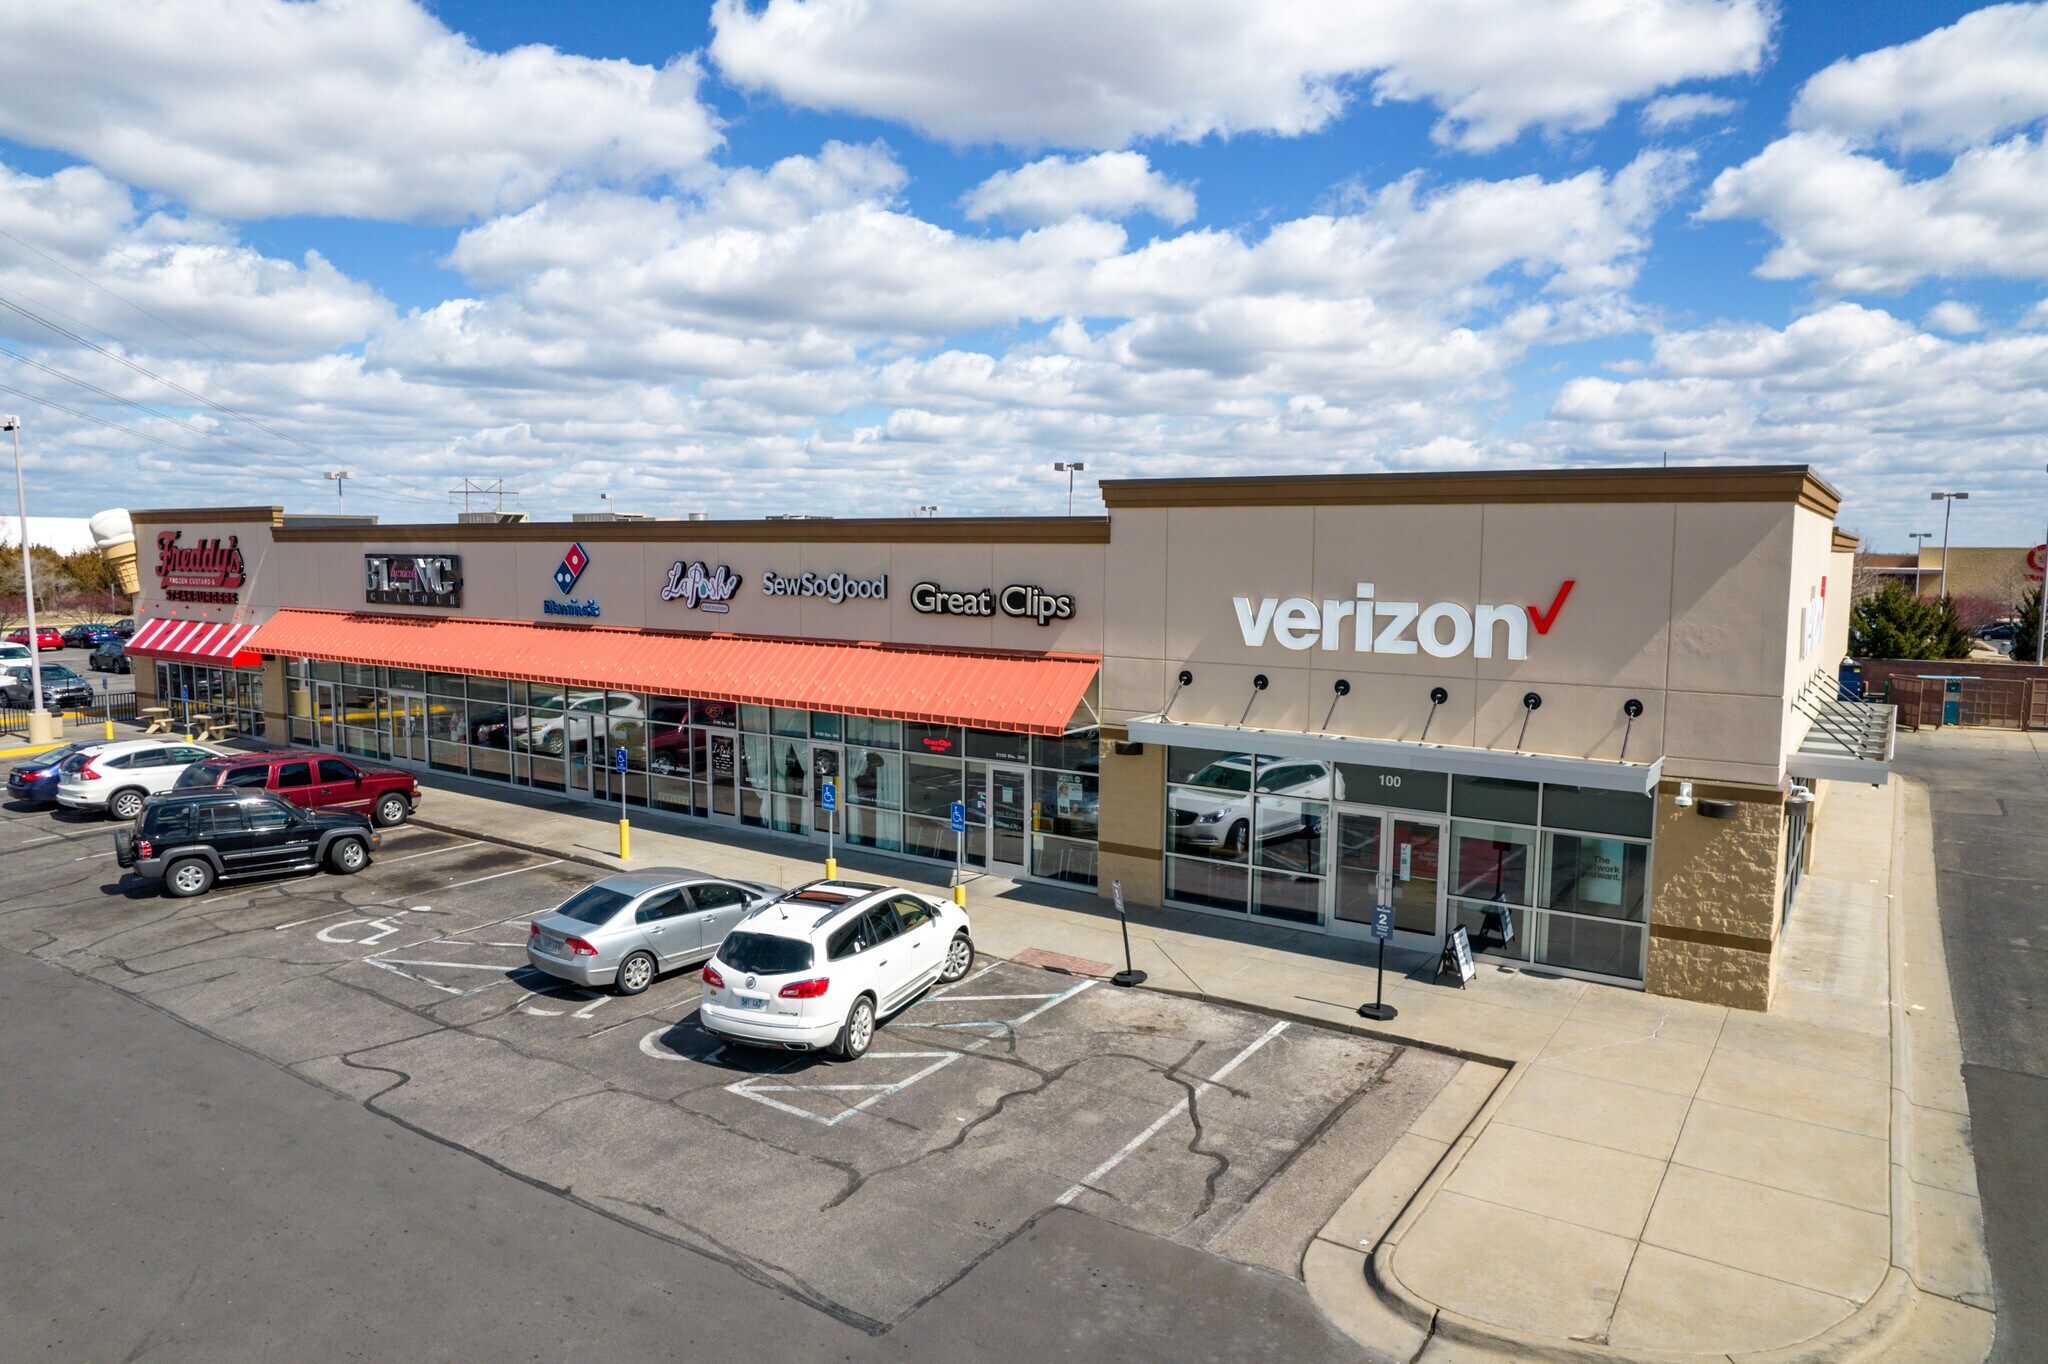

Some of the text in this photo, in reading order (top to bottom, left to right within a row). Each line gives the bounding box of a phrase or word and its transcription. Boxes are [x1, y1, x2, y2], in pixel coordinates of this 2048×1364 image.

[155, 531, 245, 585] Freddy's
[169, 577, 188, 585] FROZEN
[165, 589, 238, 604] STEAKBURGERS
[370, 592, 456, 605] GLAMOUR
[544, 598, 600, 617] Domino's
[911, 583, 1073, 626] Great Clips
[1233, 582, 1527, 660] verizon
[1379, 774, 1401, 788] 100
[1593, 855, 1610, 864] The
[1597, 872, 1621, 881] want.
[1379, 913, 1388, 925] 2
